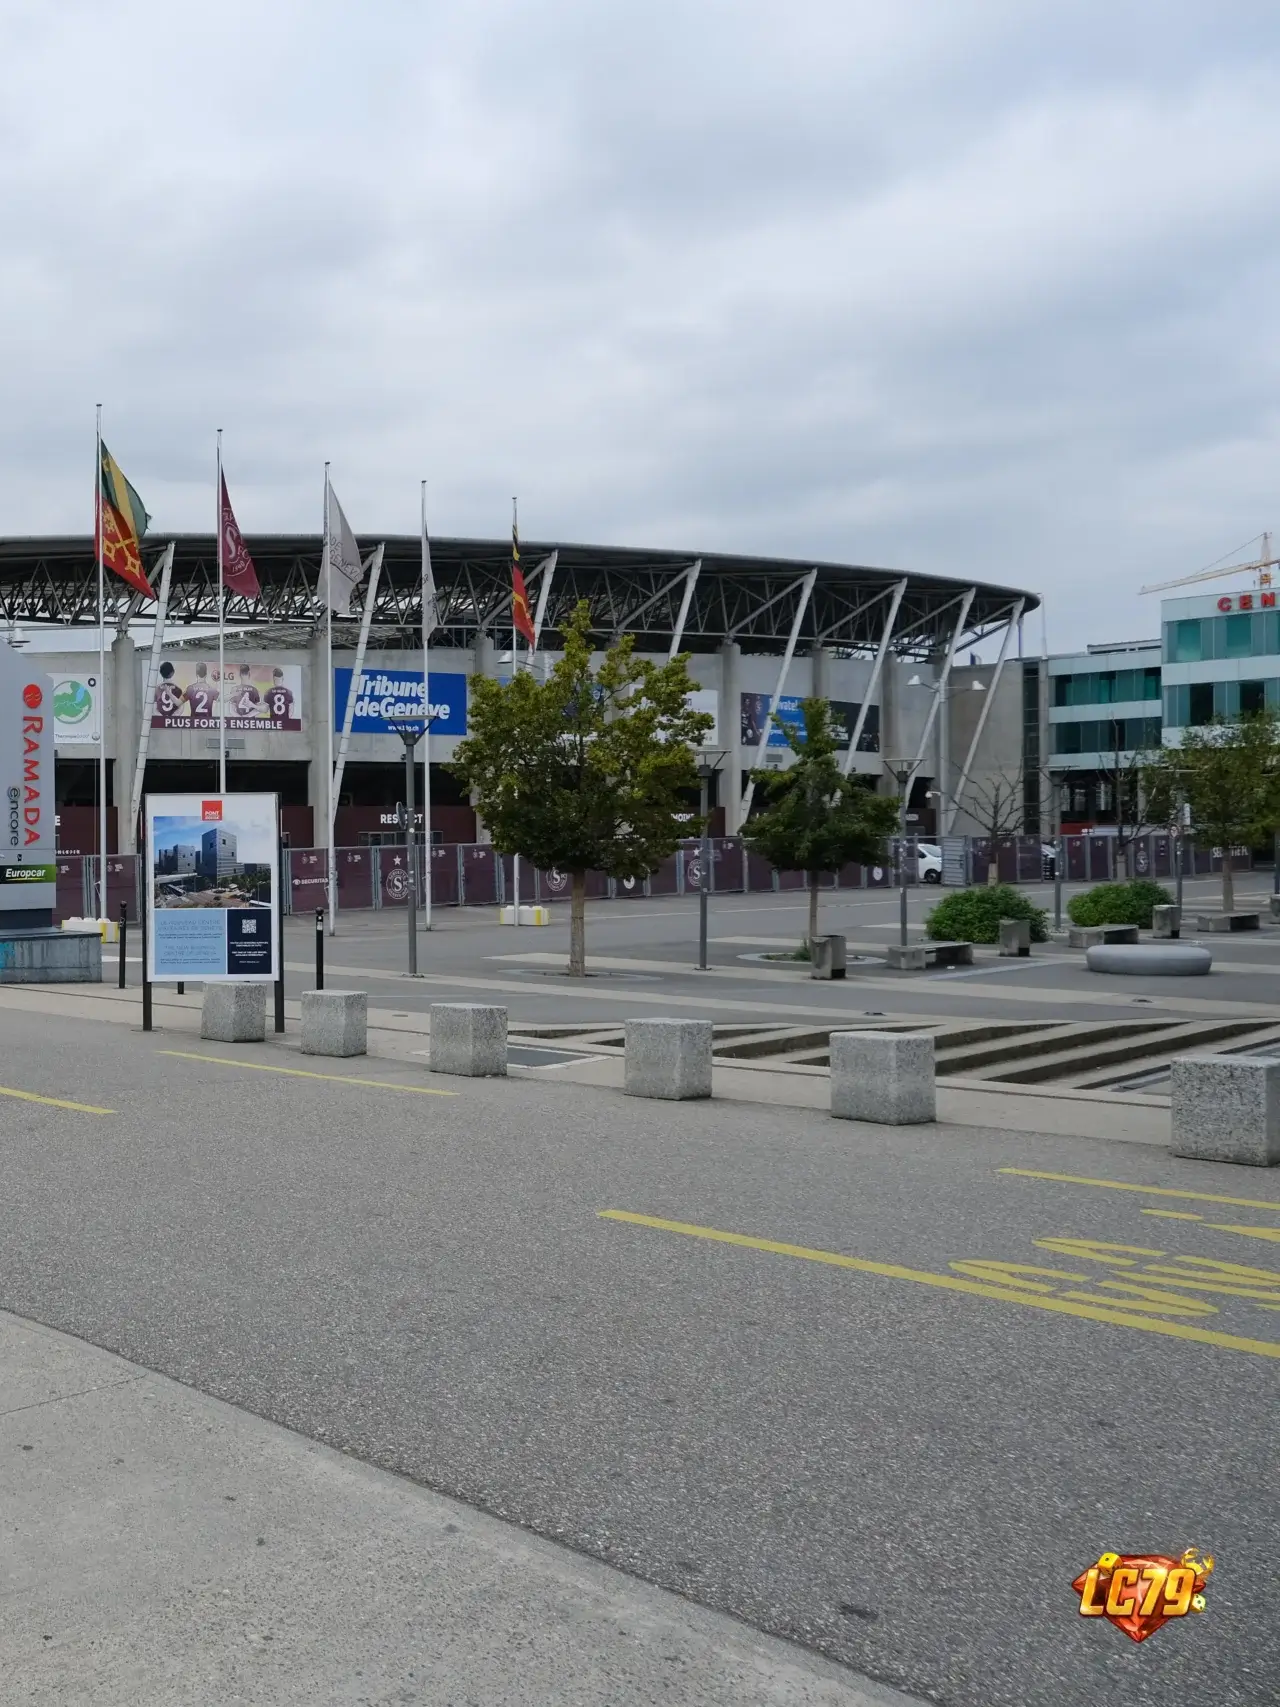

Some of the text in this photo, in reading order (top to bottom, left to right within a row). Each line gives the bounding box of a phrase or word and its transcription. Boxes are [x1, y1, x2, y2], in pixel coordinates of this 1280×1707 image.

[195, 691, 208, 713] 2
[273, 694, 286, 715] 8
[165, 718, 191, 728] PLUS
[231, 719, 283, 730] ENSEMBLE
[22, 715, 44, 847] RAMADA
[8, 786, 20, 847] encore
[380, 813, 424, 824] RESCT
[5, 867, 47, 879] Europcar
